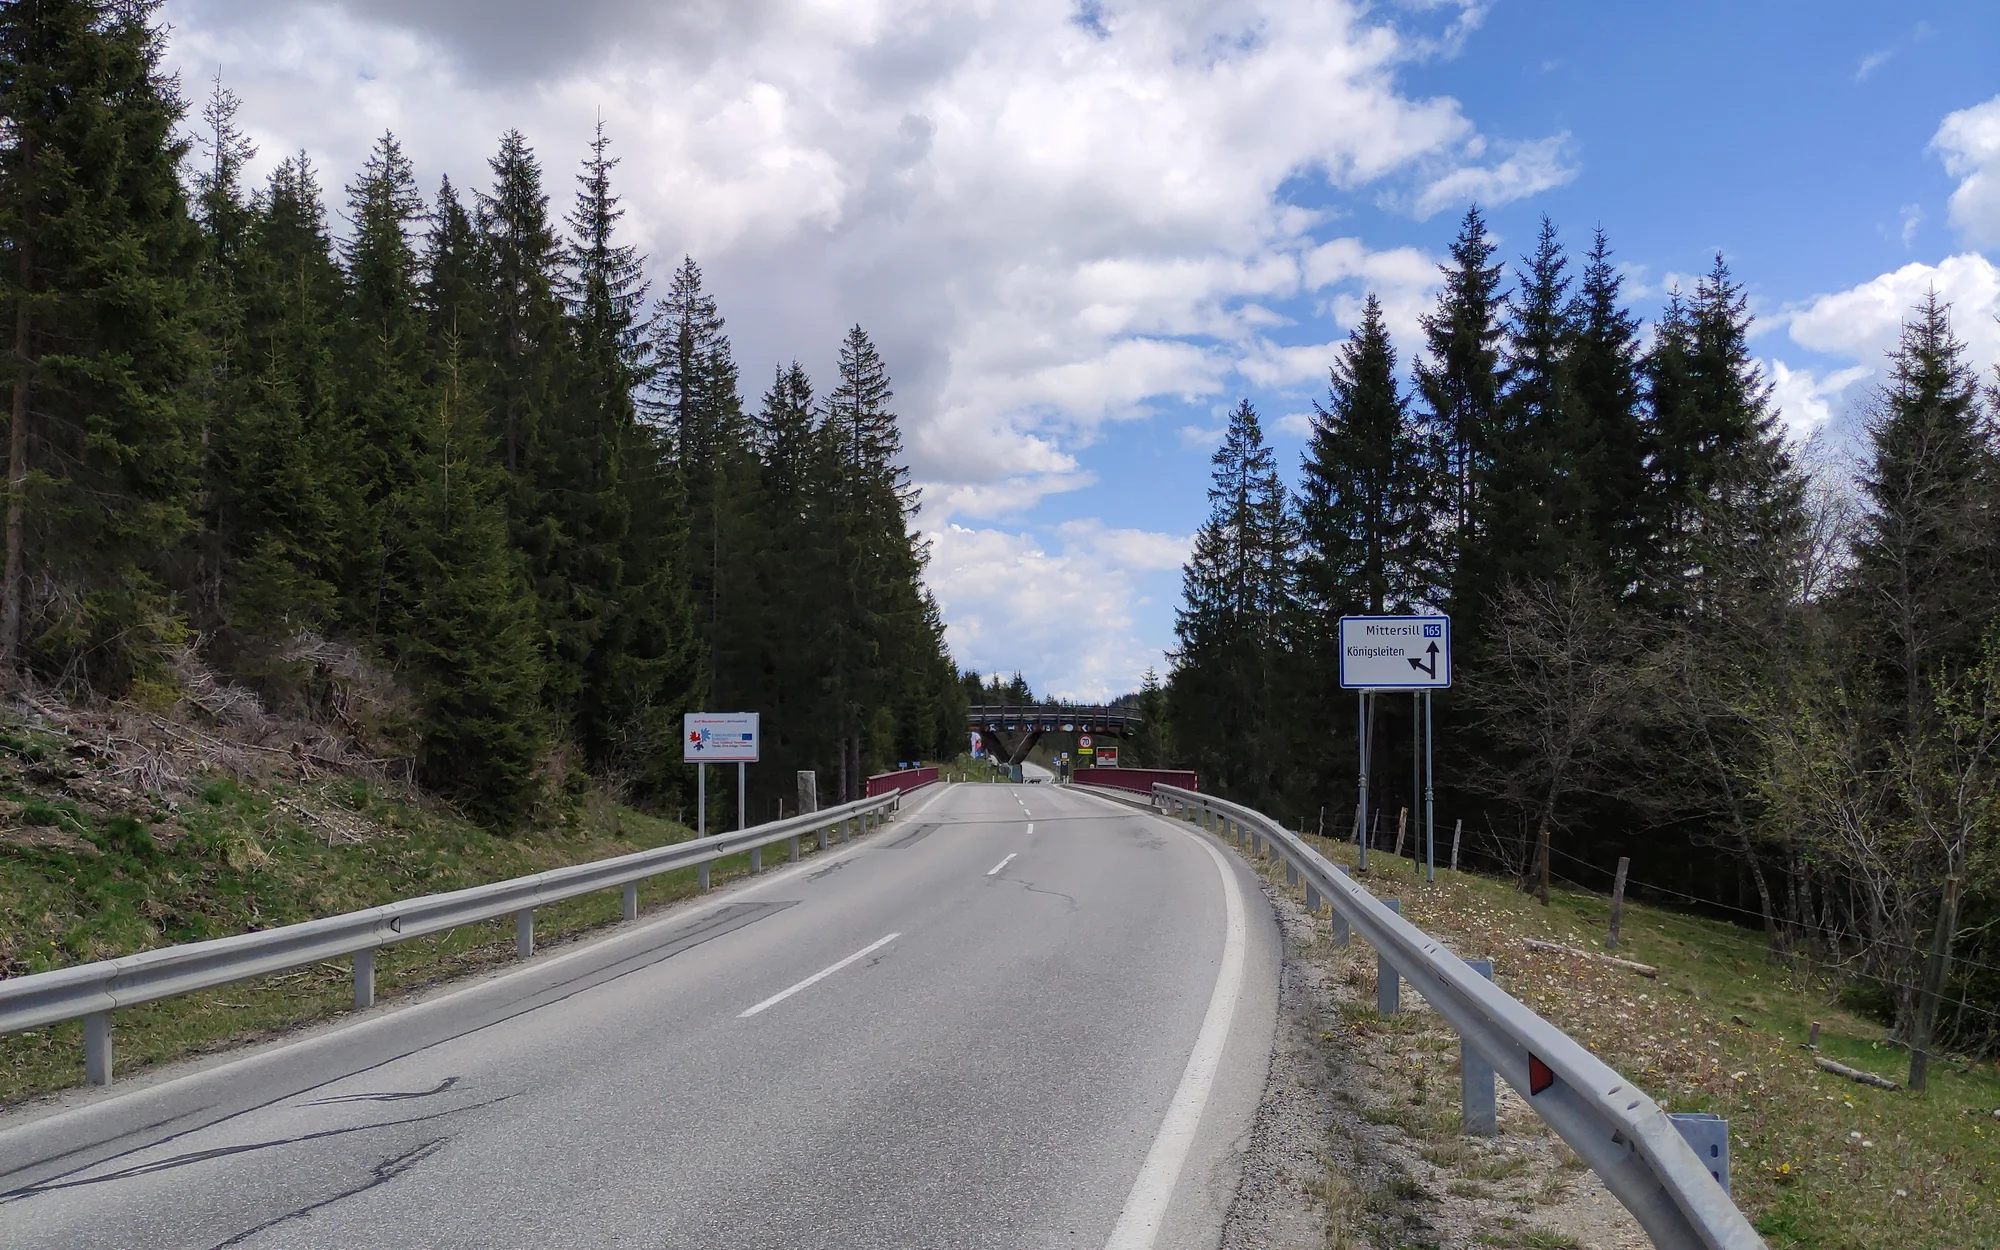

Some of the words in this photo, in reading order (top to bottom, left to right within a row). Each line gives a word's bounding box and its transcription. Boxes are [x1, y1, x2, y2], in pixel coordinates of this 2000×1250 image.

[1366, 625, 1420, 636] Mittersill
[1424, 626, 1440, 636] 165
[1347, 646, 1405, 659] Königsleiten
